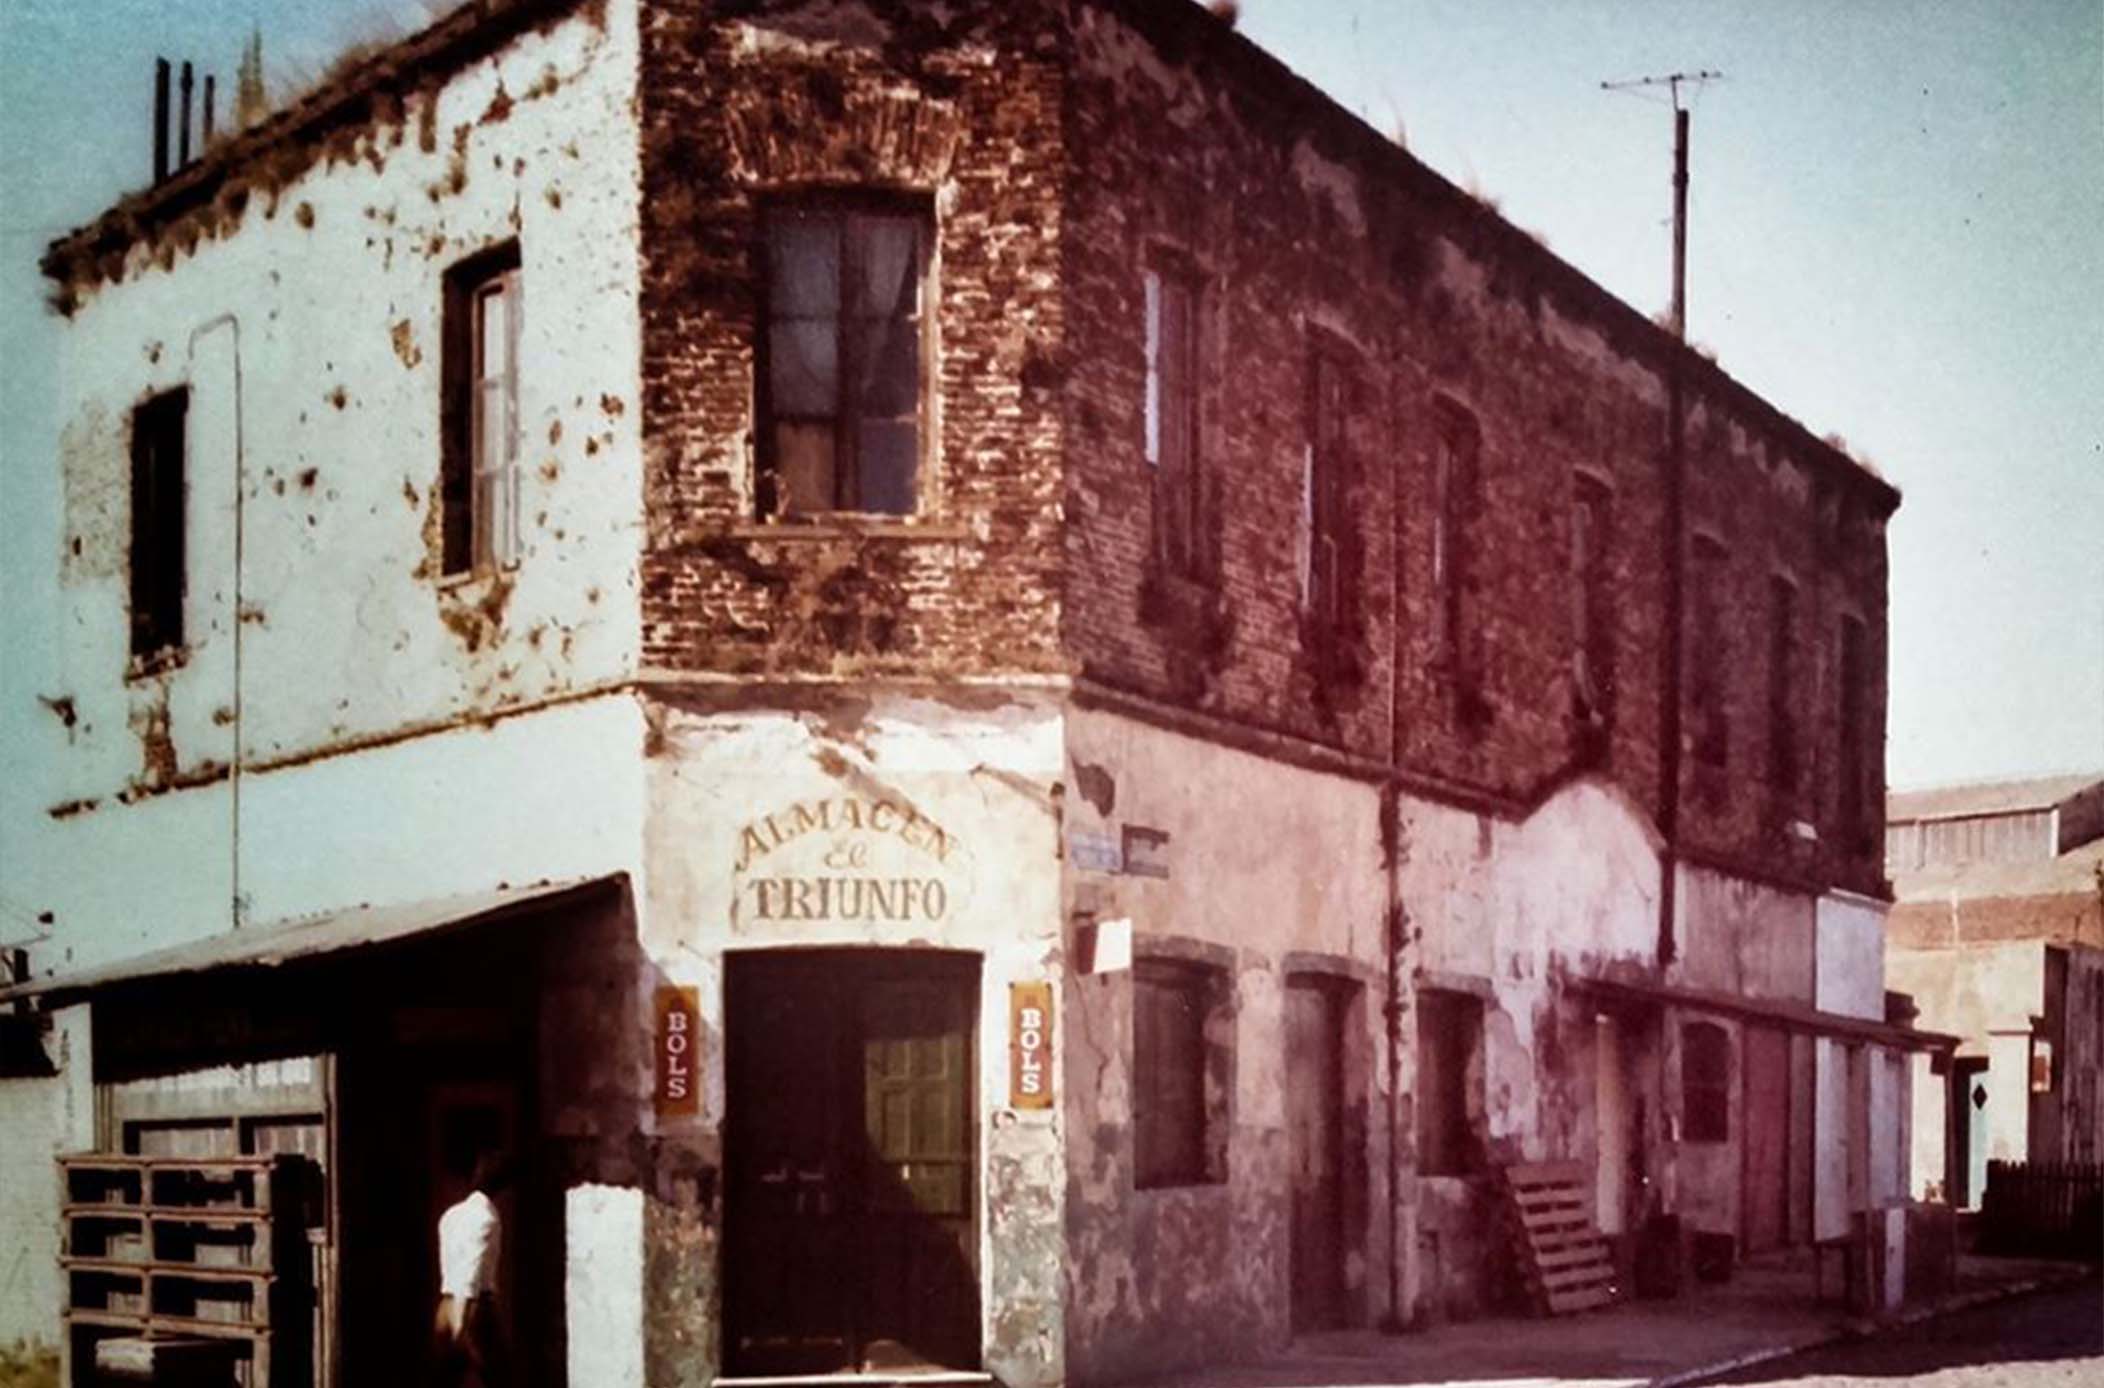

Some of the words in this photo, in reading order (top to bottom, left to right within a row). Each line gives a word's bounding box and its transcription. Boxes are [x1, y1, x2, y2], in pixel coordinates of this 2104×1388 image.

[735, 797, 959, 871] ALMACEN
[748, 877, 947, 921] TRIUNFO
[667, 1012, 688, 1098] BOLS
[1020, 1008, 1042, 1093] BOLS
